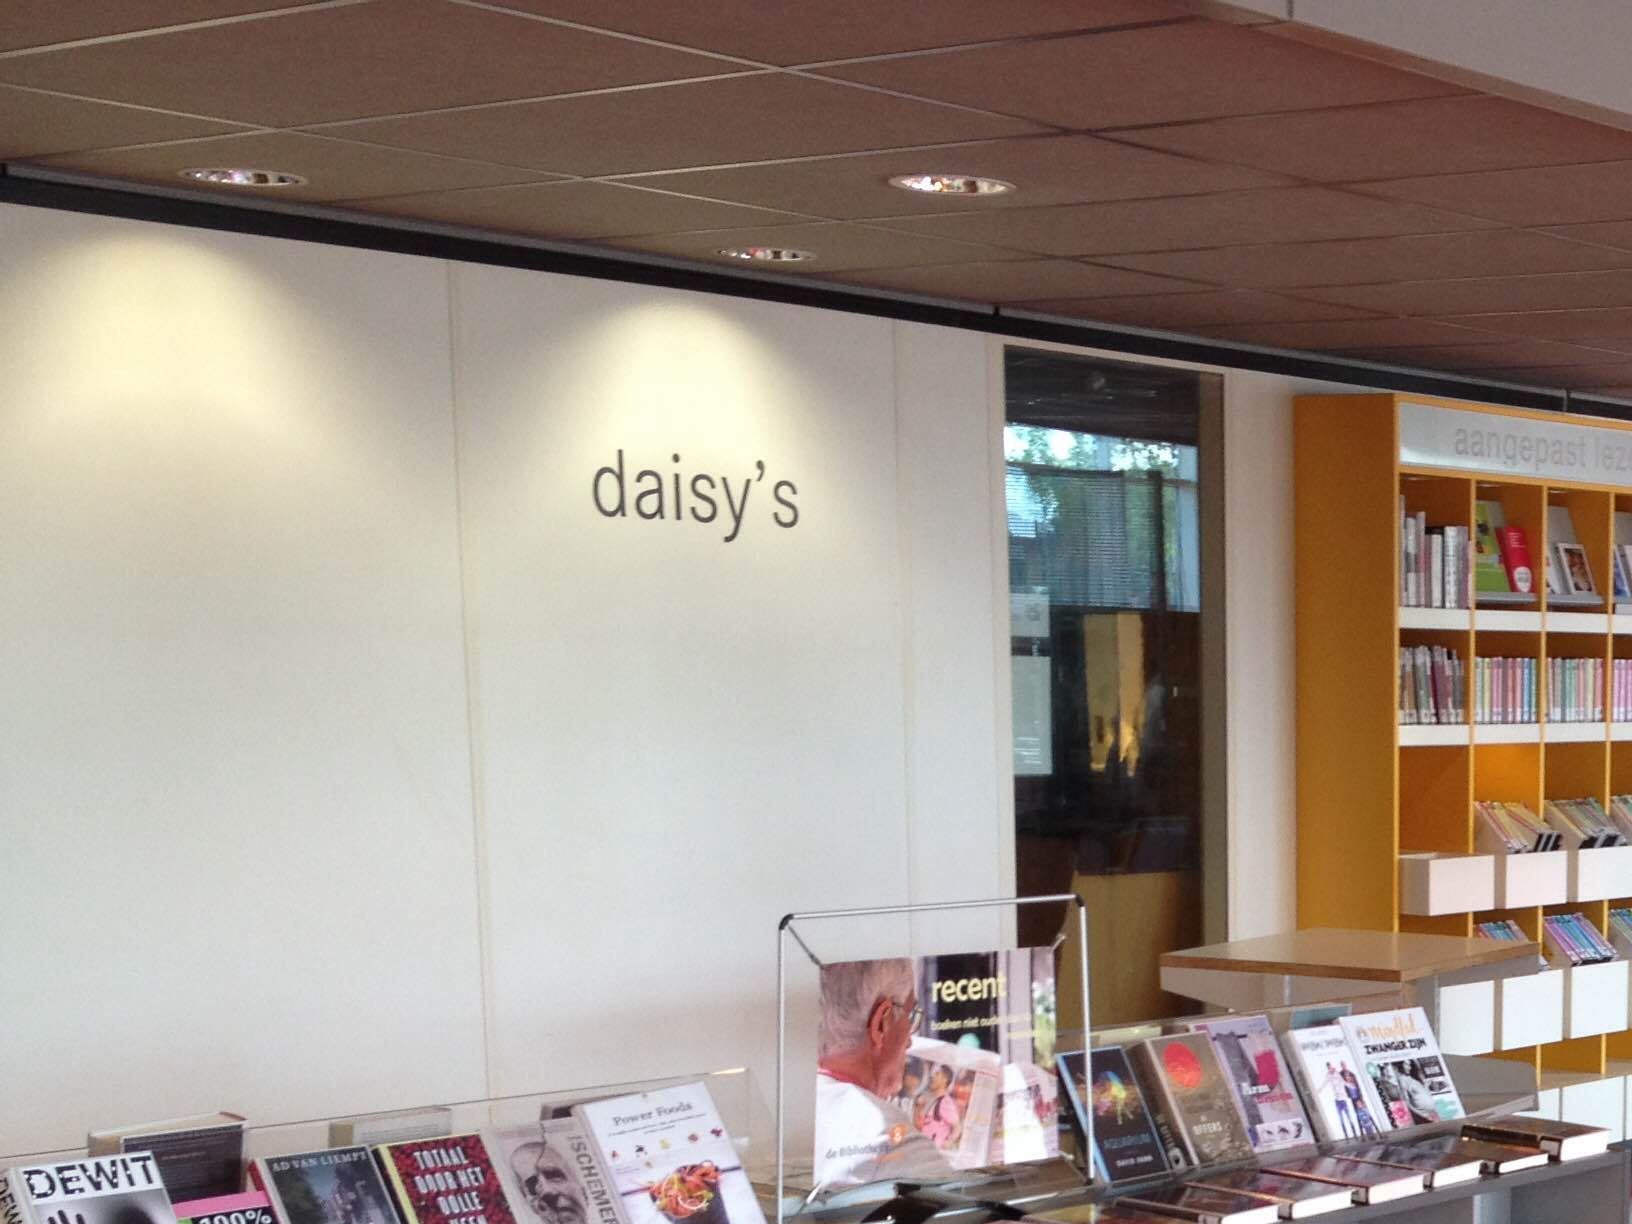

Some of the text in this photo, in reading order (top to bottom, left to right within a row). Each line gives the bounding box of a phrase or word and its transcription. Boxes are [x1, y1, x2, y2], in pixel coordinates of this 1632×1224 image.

[1454, 427, 1586, 471] aangepast
[592, 449, 799, 542] daisy's
[931, 973, 1007, 1004] recent
[611, 1110, 653, 1127] Power
[655, 1101, 694, 1118] Foods
[272, 1150, 368, 1172] AD VAN LIEMPT
[413, 1146, 469, 1170] TOTAAL
[414, 1166, 485, 1194] DOOR HET
[436, 1191, 484, 1215] DOLLE
